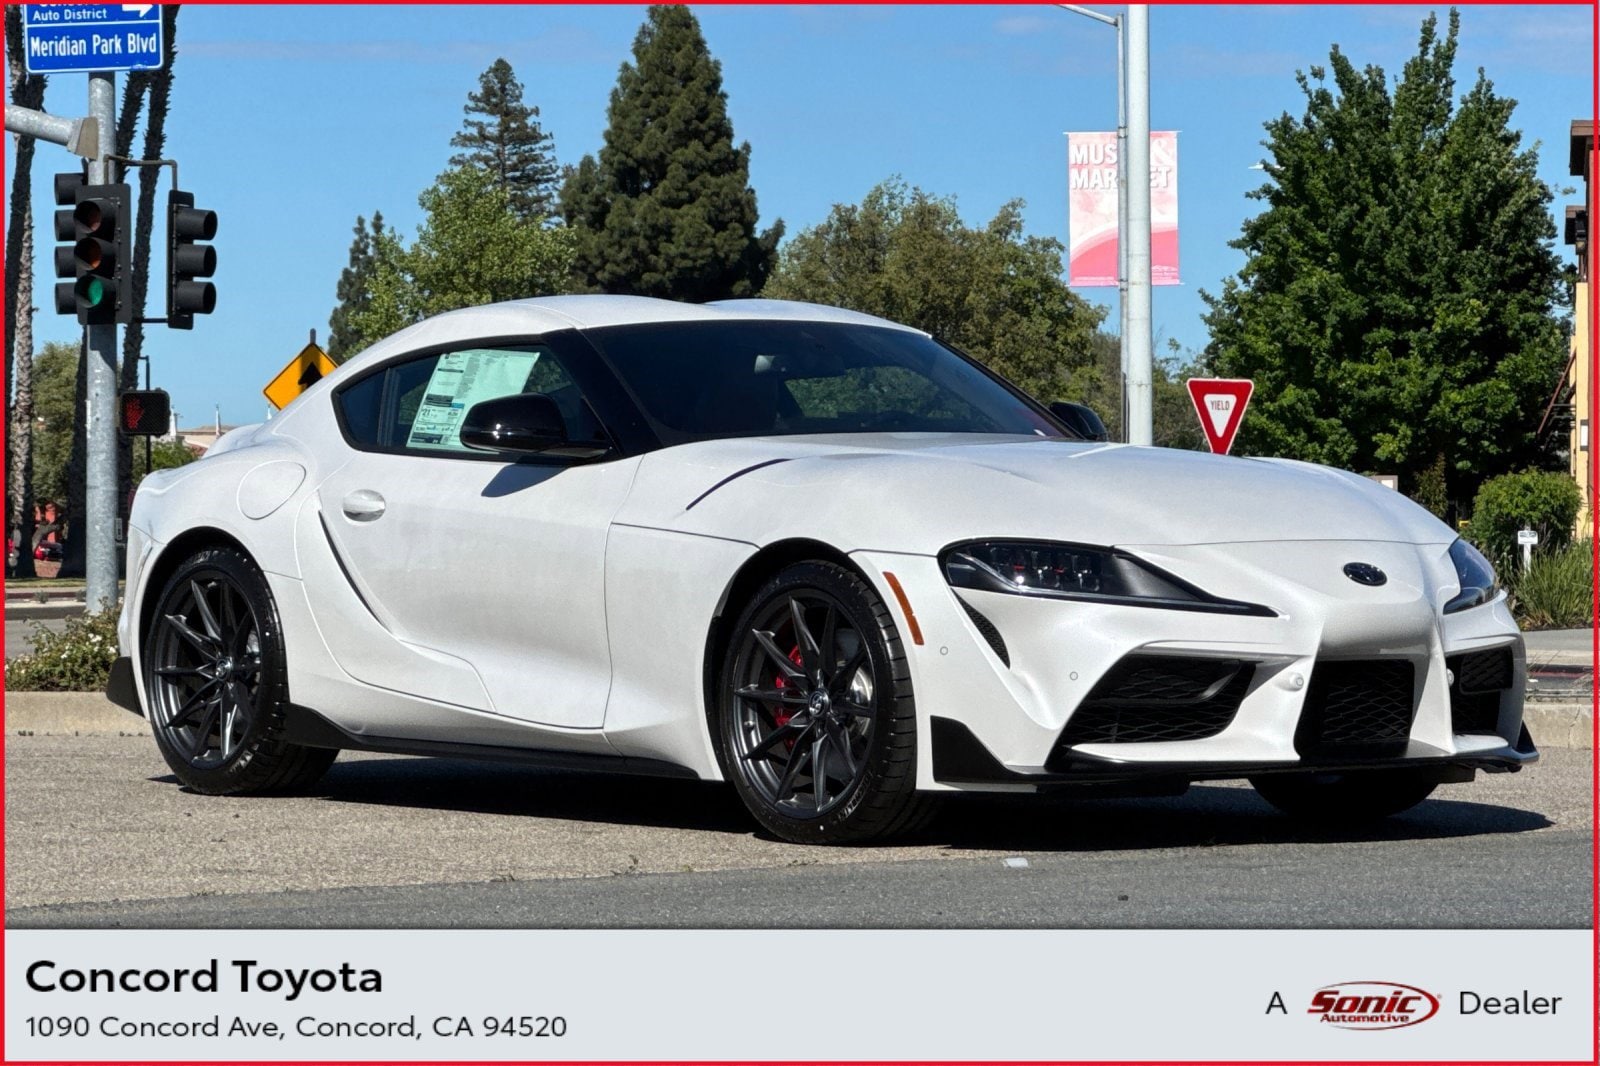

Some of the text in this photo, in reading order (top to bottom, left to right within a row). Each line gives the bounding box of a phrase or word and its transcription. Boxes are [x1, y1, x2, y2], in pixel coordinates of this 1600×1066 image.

[33, 8, 107, 21] Auto District
[30, 32, 157, 57] Meridian Park Blvd
[1070, 167, 1172, 190] MARET
[1210, 400, 1230, 411] YIELD
